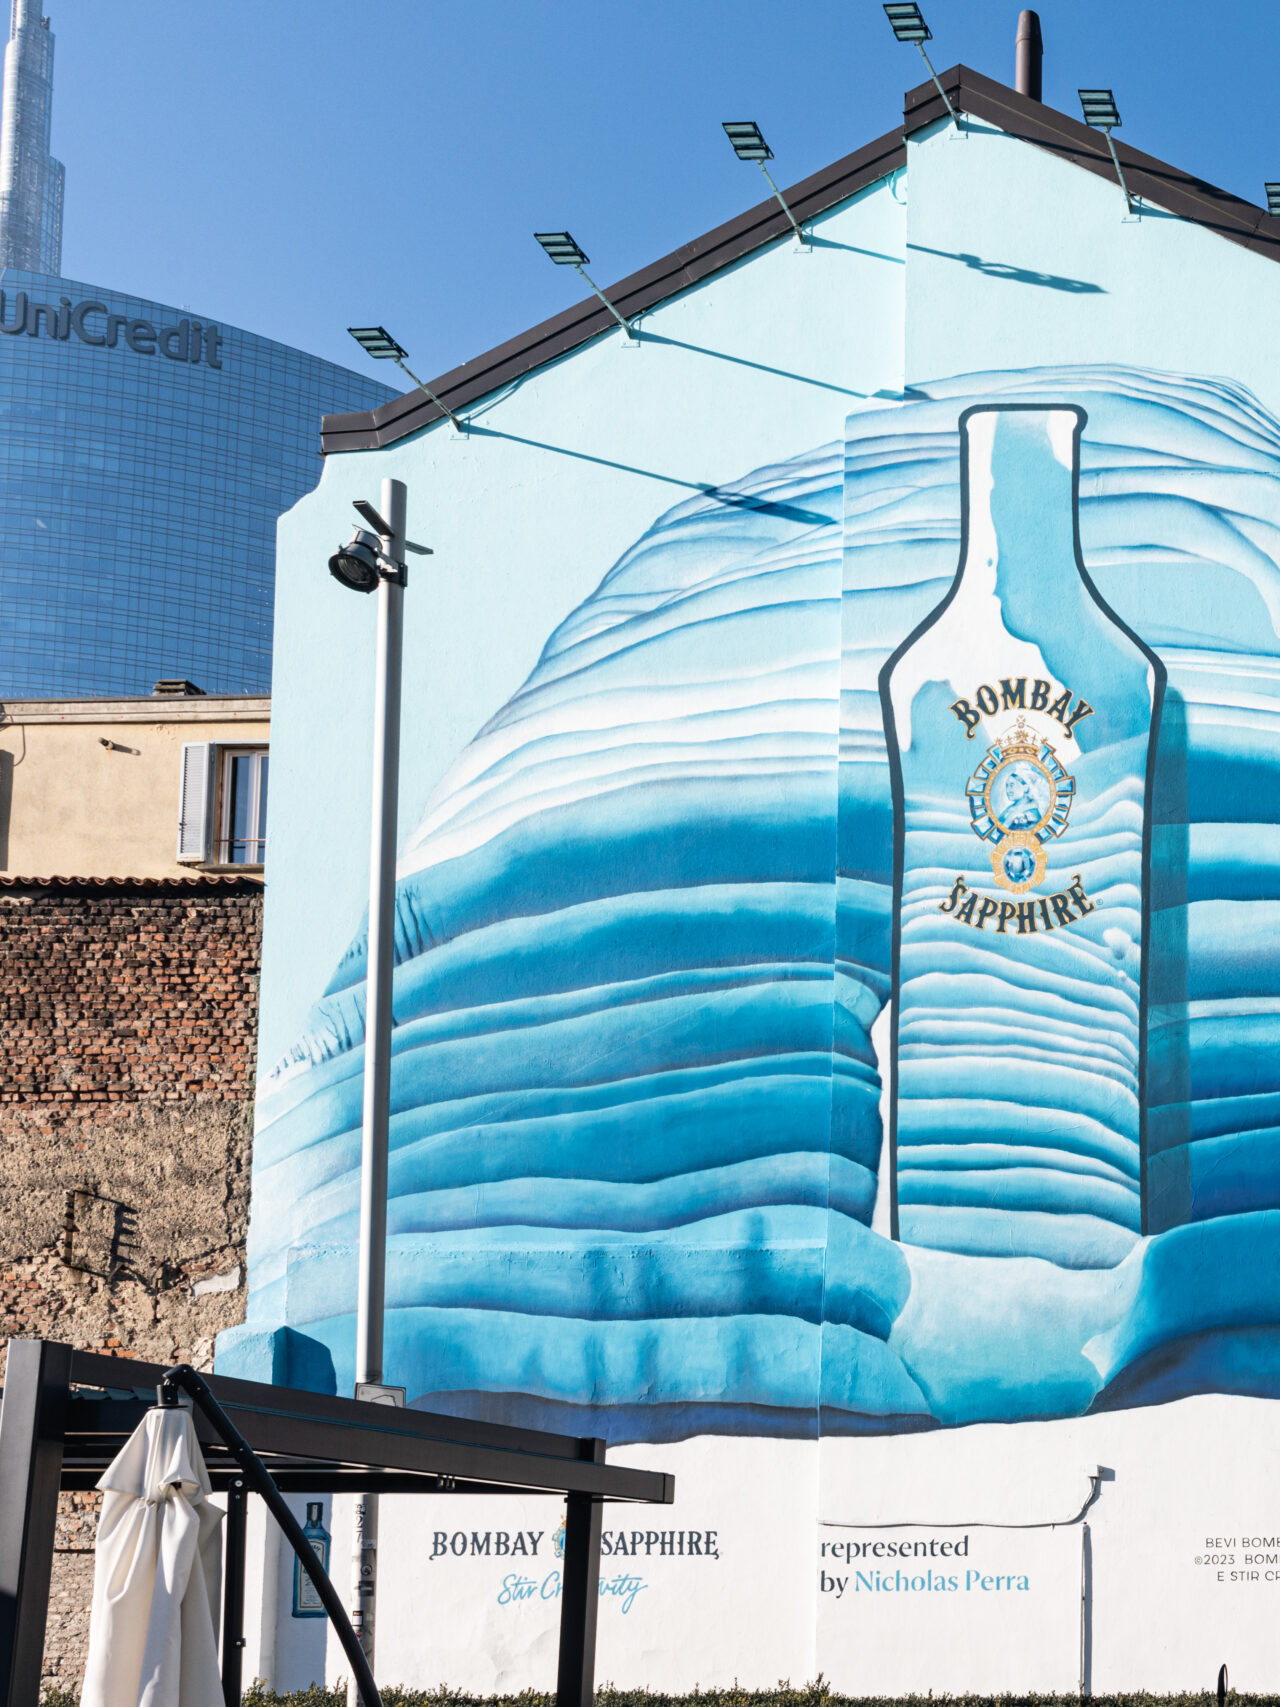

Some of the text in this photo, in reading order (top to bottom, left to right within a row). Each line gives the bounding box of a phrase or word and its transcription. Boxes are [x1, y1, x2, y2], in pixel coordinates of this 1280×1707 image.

[0, 288, 223, 369] UniCredit
[949, 676, 1095, 740] BOMBAY
[938, 873, 1096, 934] SAPPHIRE
[429, 1530, 720, 1560] BOMBAY SAPPHIRE
[820, 1535, 969, 1564] represented
[1205, 1537, 1236, 1548] BEVI
[820, 1569, 1030, 1599] by Nicholas Perra
[1217, 1570, 1225, 1582] E
[1230, 1570, 1259, 1582] STIR
[497, 1570, 648, 1614] Stir Crvity
